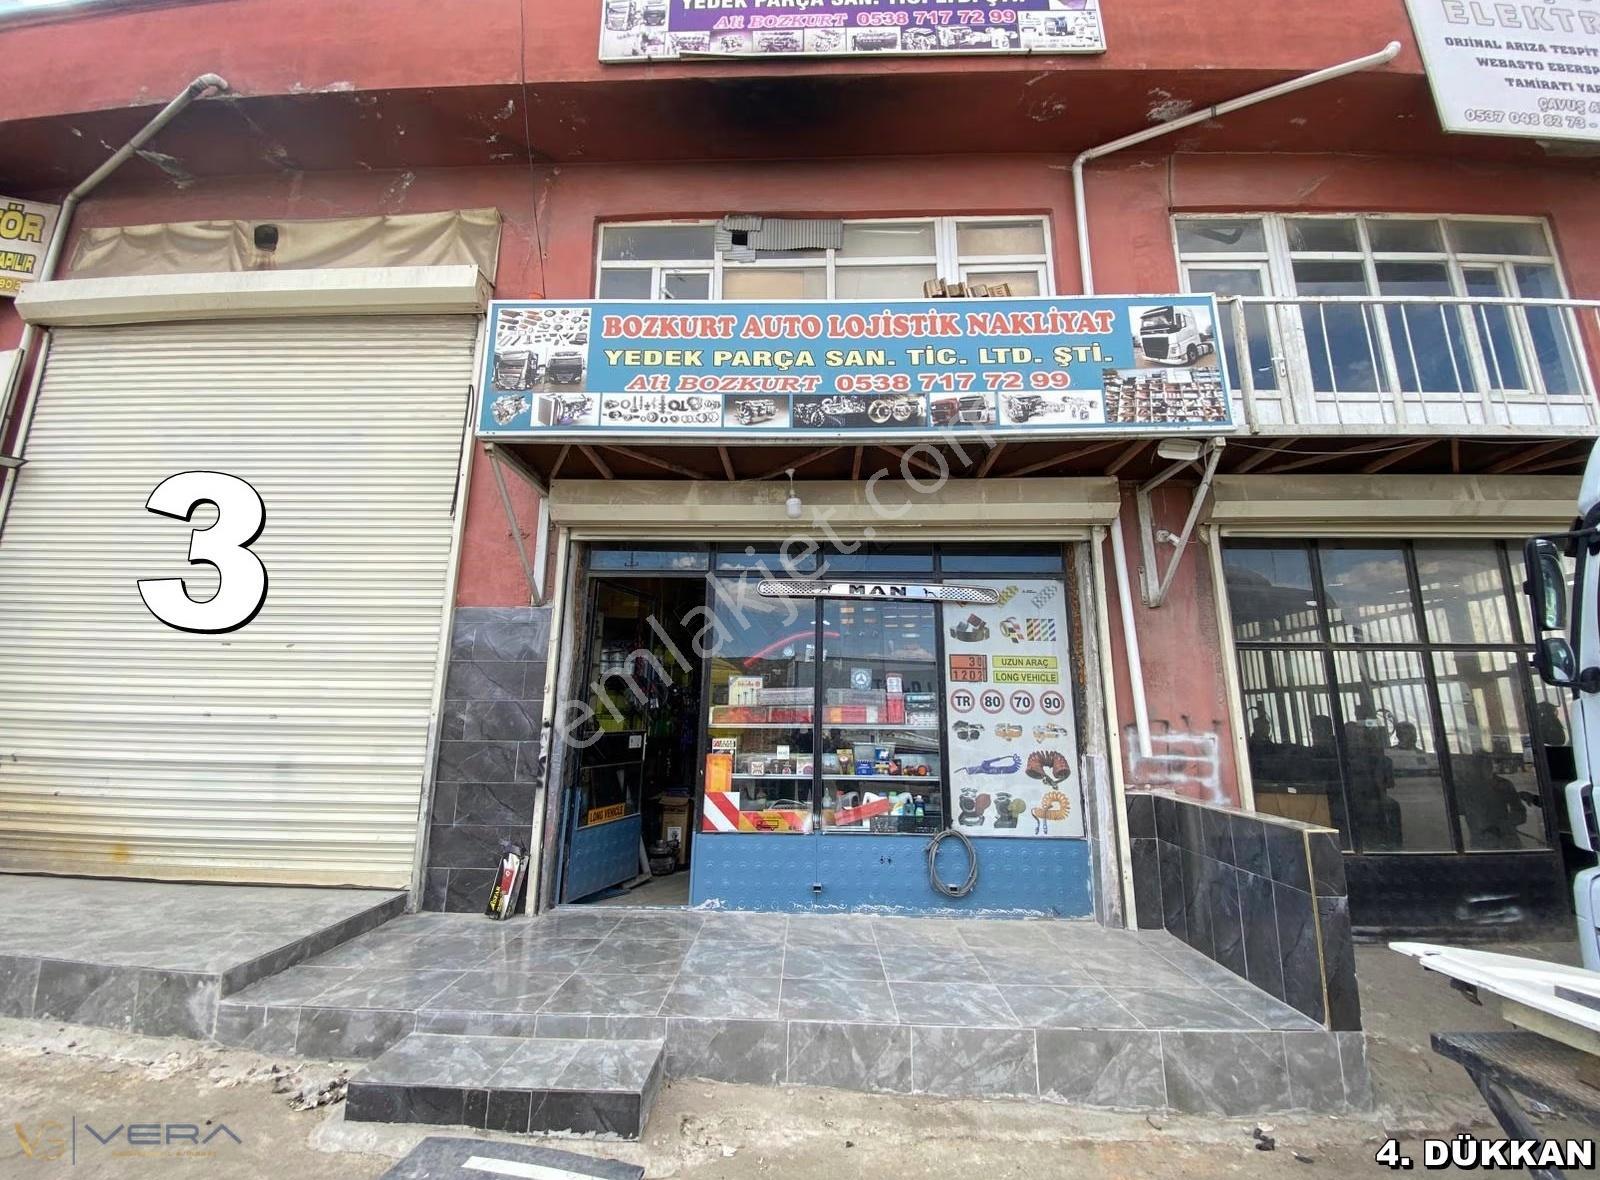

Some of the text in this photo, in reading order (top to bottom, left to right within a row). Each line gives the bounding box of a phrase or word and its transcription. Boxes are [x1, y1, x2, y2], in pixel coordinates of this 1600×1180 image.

[713, 9, 1017, 29] Ali BOZKURT 0538 717 72 99
[1505, 41, 1547, 53] ARIZA
[1476, 56, 1544, 71] WEBASTO
[1537, 97, 1586, 115] ÇAVUŞ
[1464, 108, 1505, 123] 0537
[603, 306, 1115, 339] BOZKURT AUTO LOJİSTİK NAKLİYAT
[605, 343, 1114, 371] YEDEK PARÇA SAN. TİC. LTD. ŞTİ.
[625, 370, 1071, 393] Ali BOZKURT 0538 717 72 99
[849, 584, 907, 596] MAN
[1001, 656, 1049, 669] UZUN ARAÇ
[995, 673, 1057, 682] LONG VEHICLE
[955, 695, 971, 707] TR
[984, 696, 1001, 707] 80
[1014, 696, 1031, 708] 70
[1044, 697, 1061, 709] 90
